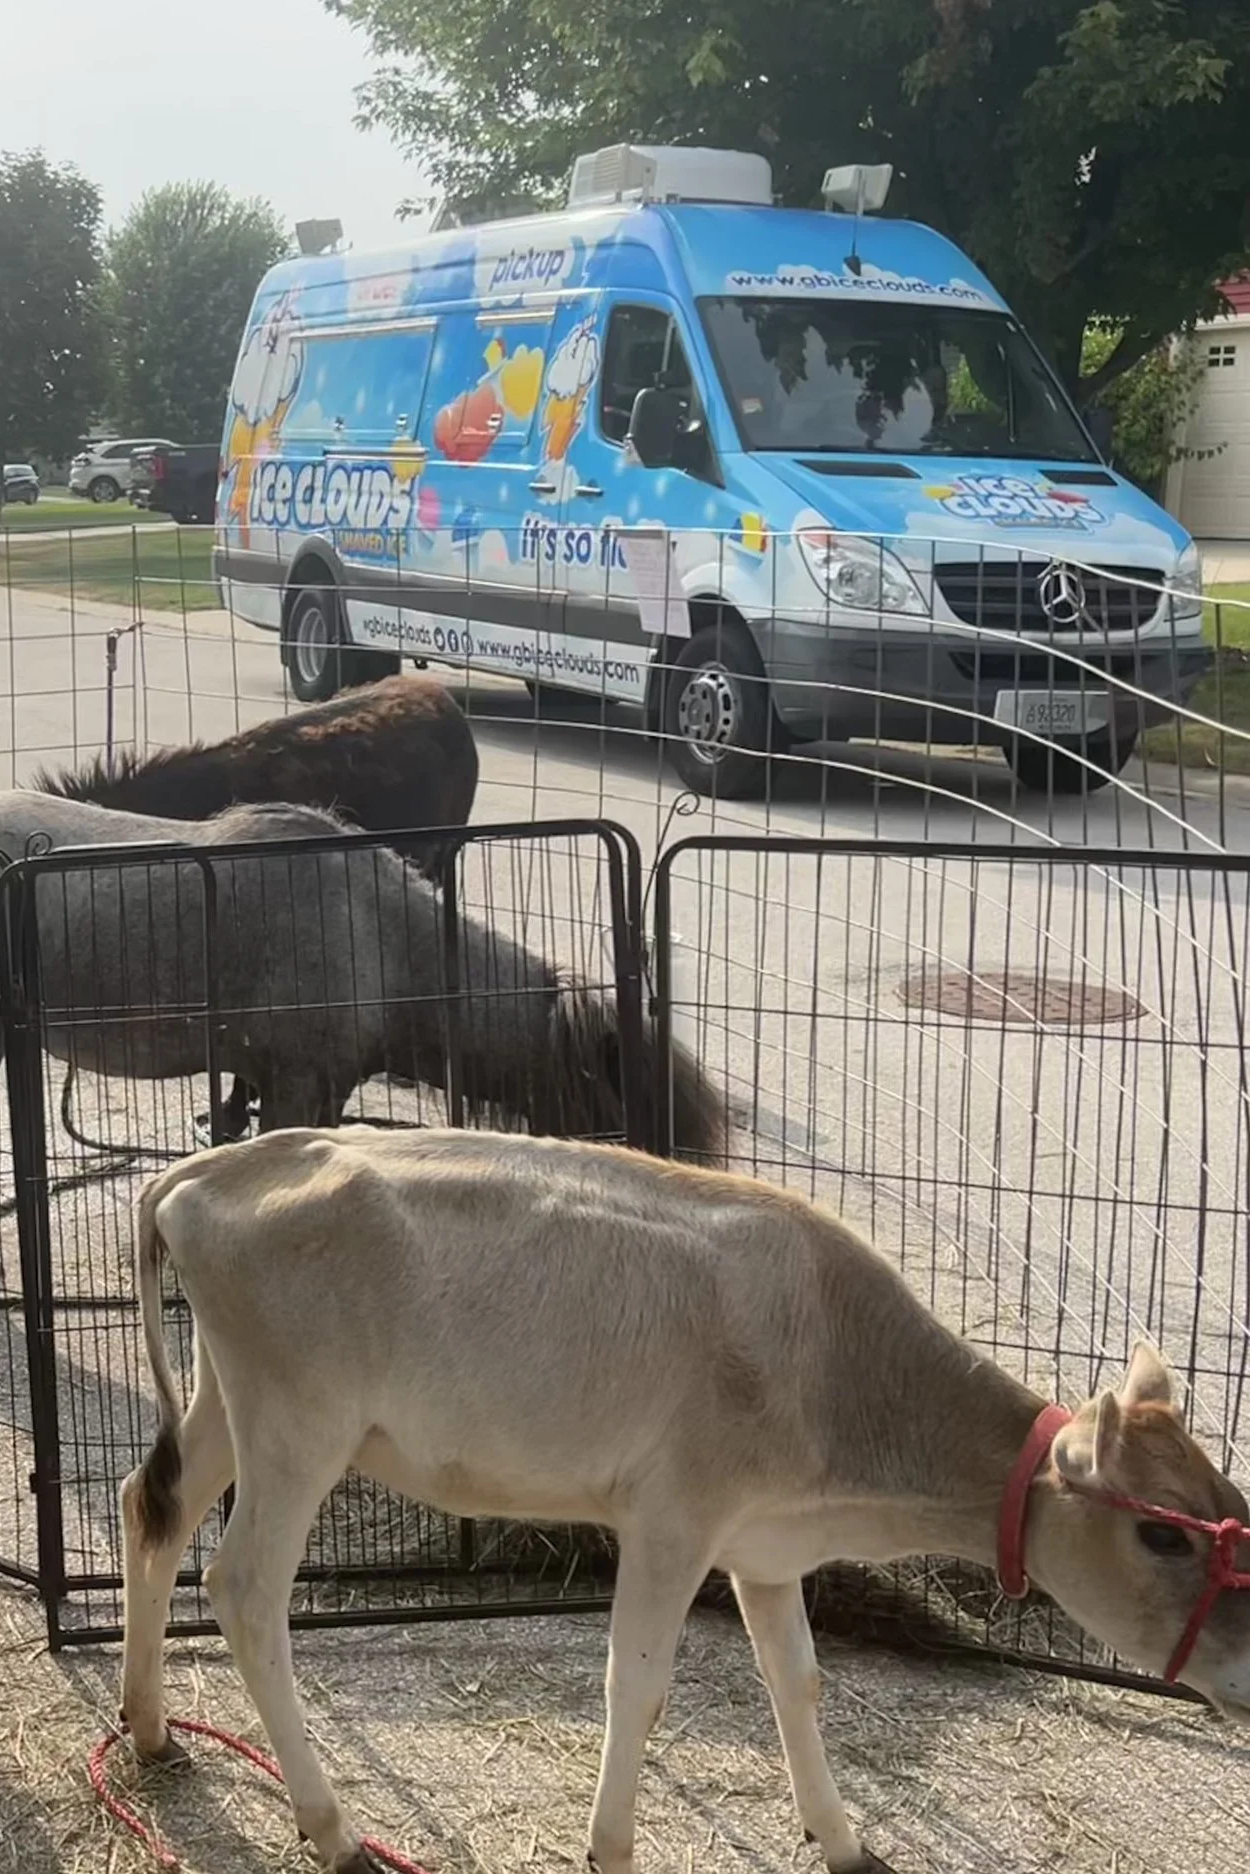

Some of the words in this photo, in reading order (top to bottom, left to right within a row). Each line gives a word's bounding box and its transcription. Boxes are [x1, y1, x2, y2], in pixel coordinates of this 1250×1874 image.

[489, 247, 566, 292] pickup
[731, 273, 983, 301] www.gbiceclouds.com
[294, 463, 414, 529] CLOUDS
[942, 495, 1105, 523] CLOUDS
[564, 528, 592, 564] so
[477, 638, 640, 684] www.gbiceclouds.com
